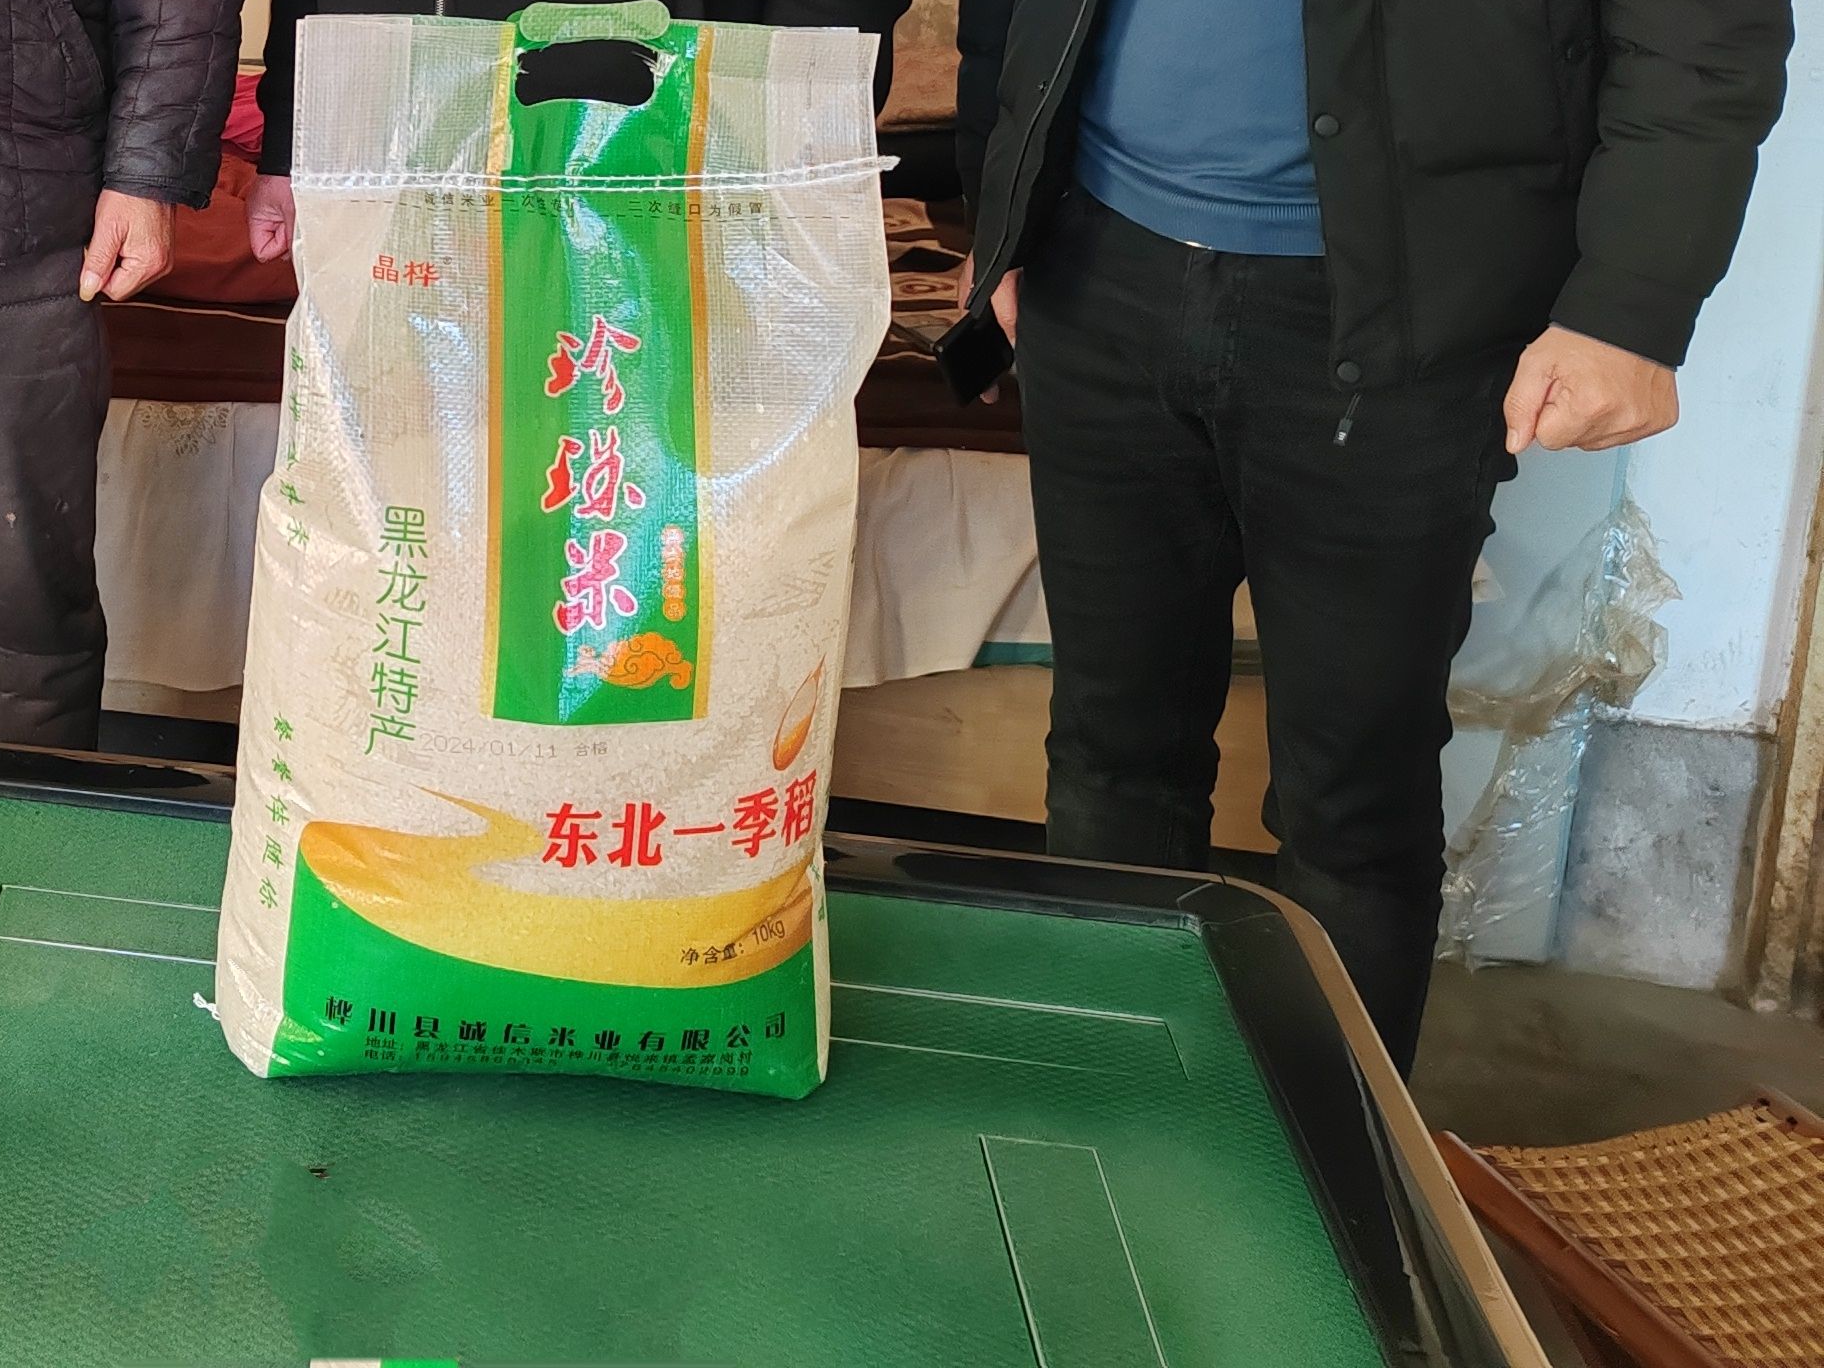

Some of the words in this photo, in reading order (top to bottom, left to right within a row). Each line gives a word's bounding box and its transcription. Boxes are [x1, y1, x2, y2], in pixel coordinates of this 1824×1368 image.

[539, 314, 646, 634] 珍珠米
[364, 505, 429, 756] 黑龙江特产
[420, 733, 558, 758] 2024/01/11
[541, 769, 820, 869] 东北一季稻
[752, 920, 785, 945] 10kg
[326, 995, 786, 1051] 桦川县诚信米业有限公司
